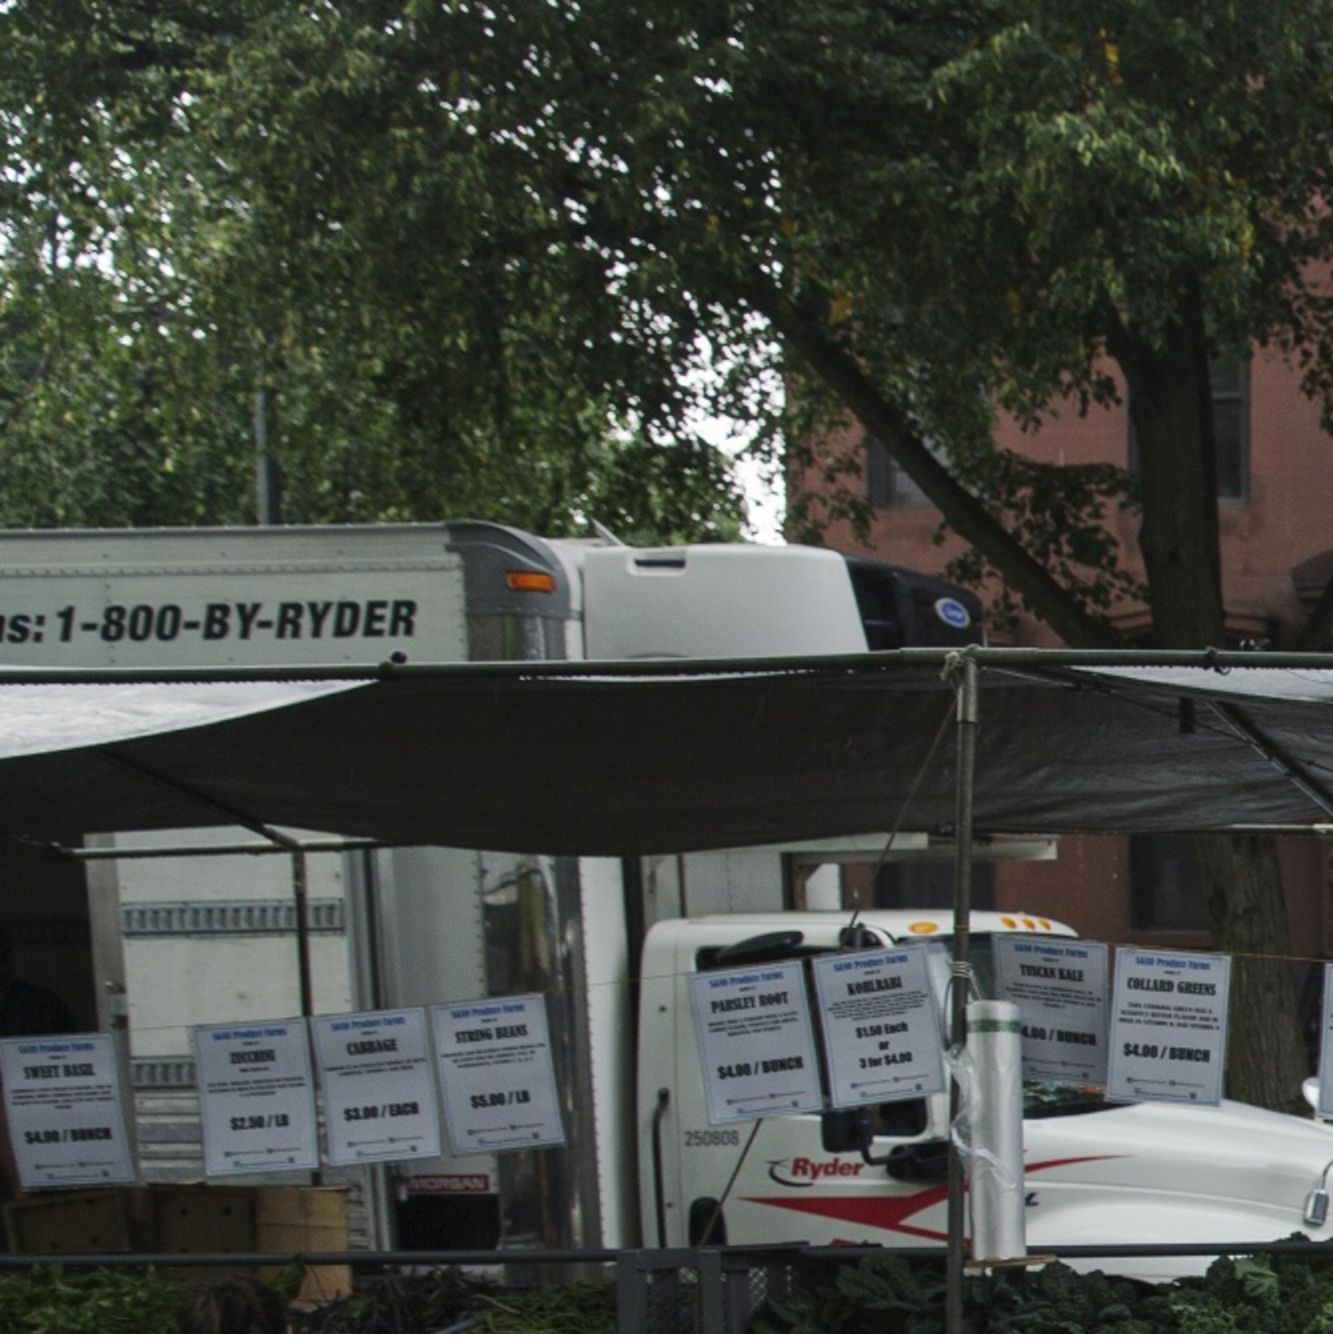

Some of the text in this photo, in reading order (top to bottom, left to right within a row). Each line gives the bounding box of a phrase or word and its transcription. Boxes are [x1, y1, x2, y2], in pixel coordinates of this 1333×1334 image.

[56, 600, 418, 643] 1-800-BY-RYDER
[1035, 944, 1065, 956] Produce
[854, 959, 884, 969] Produce
[885, 954, 908, 964] Farms
[1156, 958, 1186, 969] Produce
[1188, 961, 1210, 971] Farms
[729, 975, 759, 986] Produce
[1020, 963, 1084, 982] TUSCAN KALE
[847, 977, 902, 996] KOHLRABI
[1127, 976, 1216, 997] COLLARD GREENS
[472, 1006, 501, 1017] Produce
[711, 992, 789, 1014] PARSLEY ROOT
[351, 1019, 382, 1029] Produce
[856, 1022, 908, 1039] $1.50 Each
[455, 1024, 528, 1044] STRING BEANS
[1057, 1029, 1096, 1046] BUNCH
[346, 1038, 398, 1056] CABBAGE
[879, 1041, 890, 1050] or
[1123, 1043, 1158, 1059] $4.00
[1169, 1046, 1210, 1062] BUNCH
[717, 1064, 752, 1080] $4.00
[762, 1056, 804, 1073] BUNCH
[859, 1052, 912, 1069] 3 for $4.00
[24, 1063, 96, 1079] SWEET BASIL
[515, 1090, 531, 1103] LB
[344, 1106, 378, 1121] $3.00
[389, 1102, 420, 1117] EACH
[230, 1116, 264, 1130] $2.50
[275, 1113, 289, 1127] LB
[685, 1129, 740, 1147] 250808
[791, 1157, 865, 1180] Ryder
[411, 1177, 486, 1190] MORGAN
